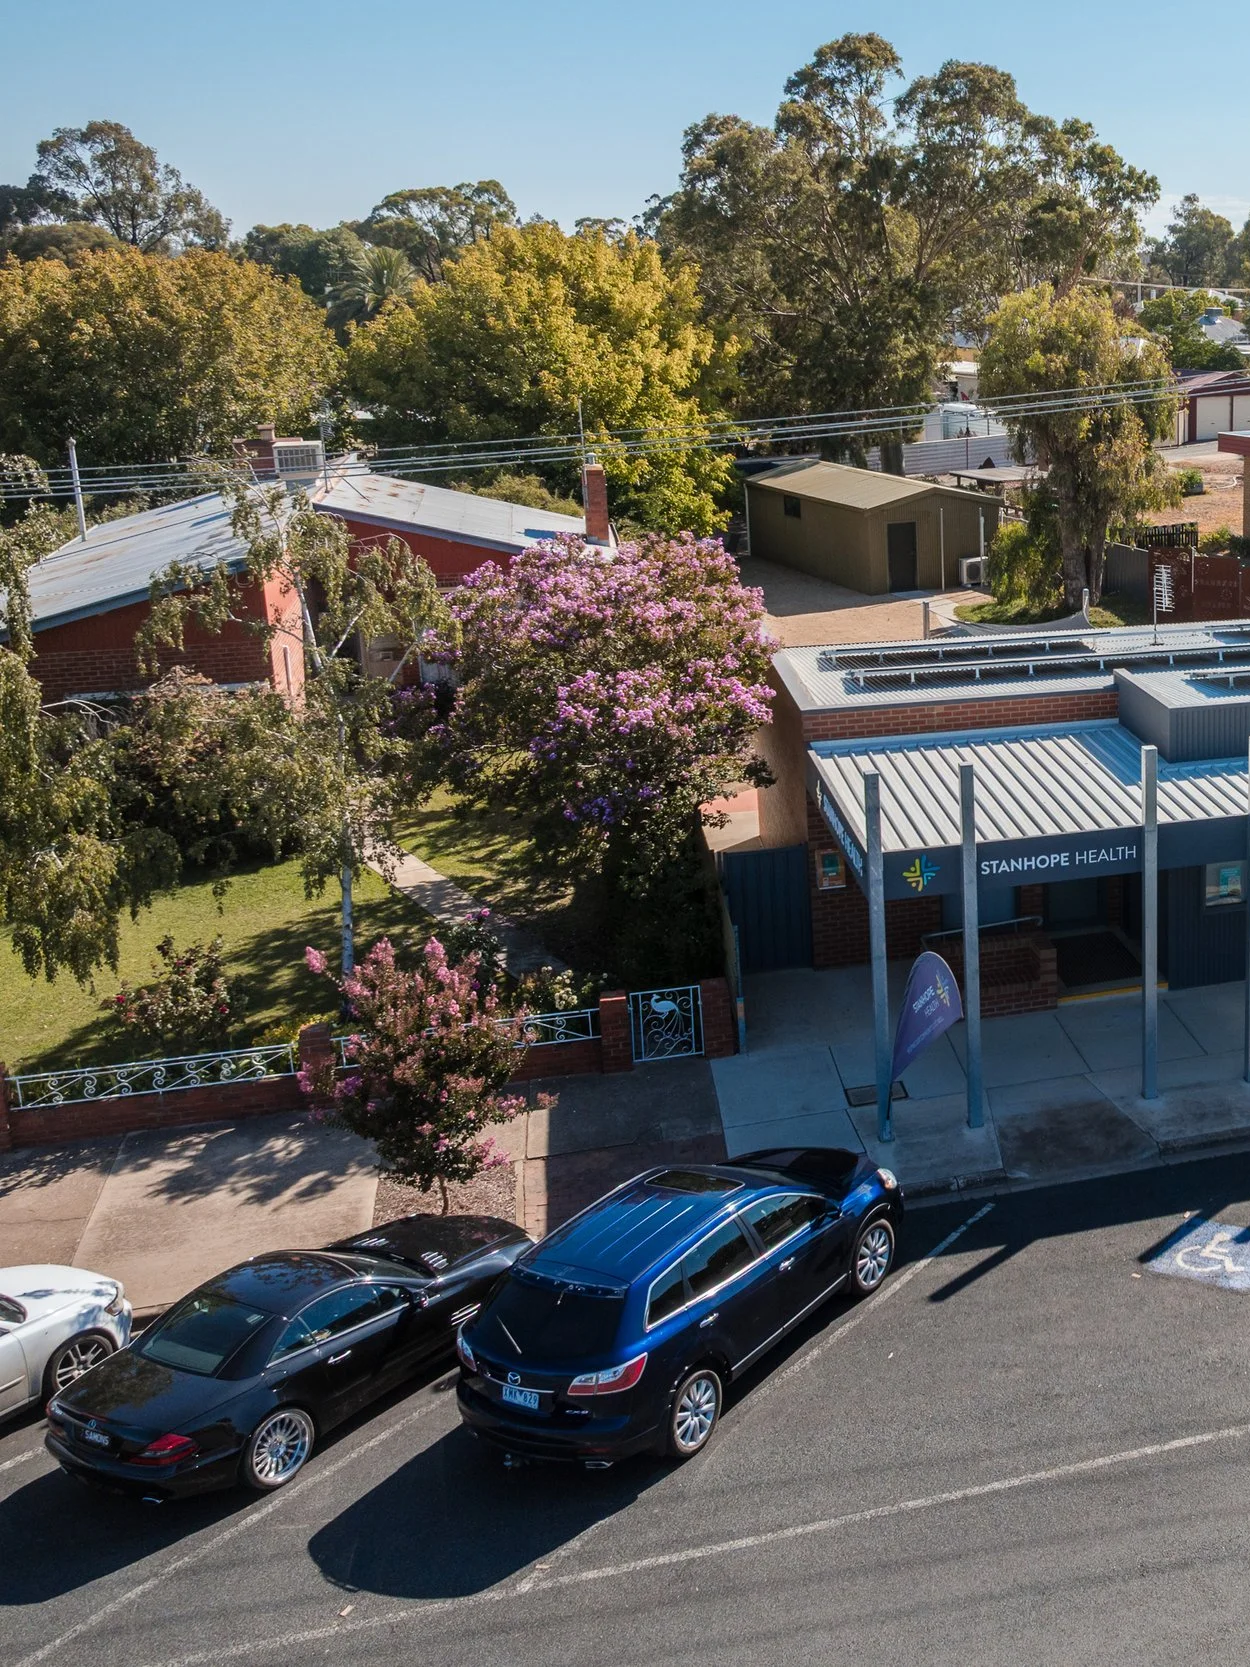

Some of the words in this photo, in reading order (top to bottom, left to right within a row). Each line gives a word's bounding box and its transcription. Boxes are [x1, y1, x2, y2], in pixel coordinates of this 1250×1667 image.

[980, 852, 1070, 875] STANHOPE
[1075, 845, 1137, 865] HEALTH
[912, 985, 935, 1013] STANHOPE
[923, 998, 940, 1018] HEALTH
[523, 1391, 537, 1405] 829
